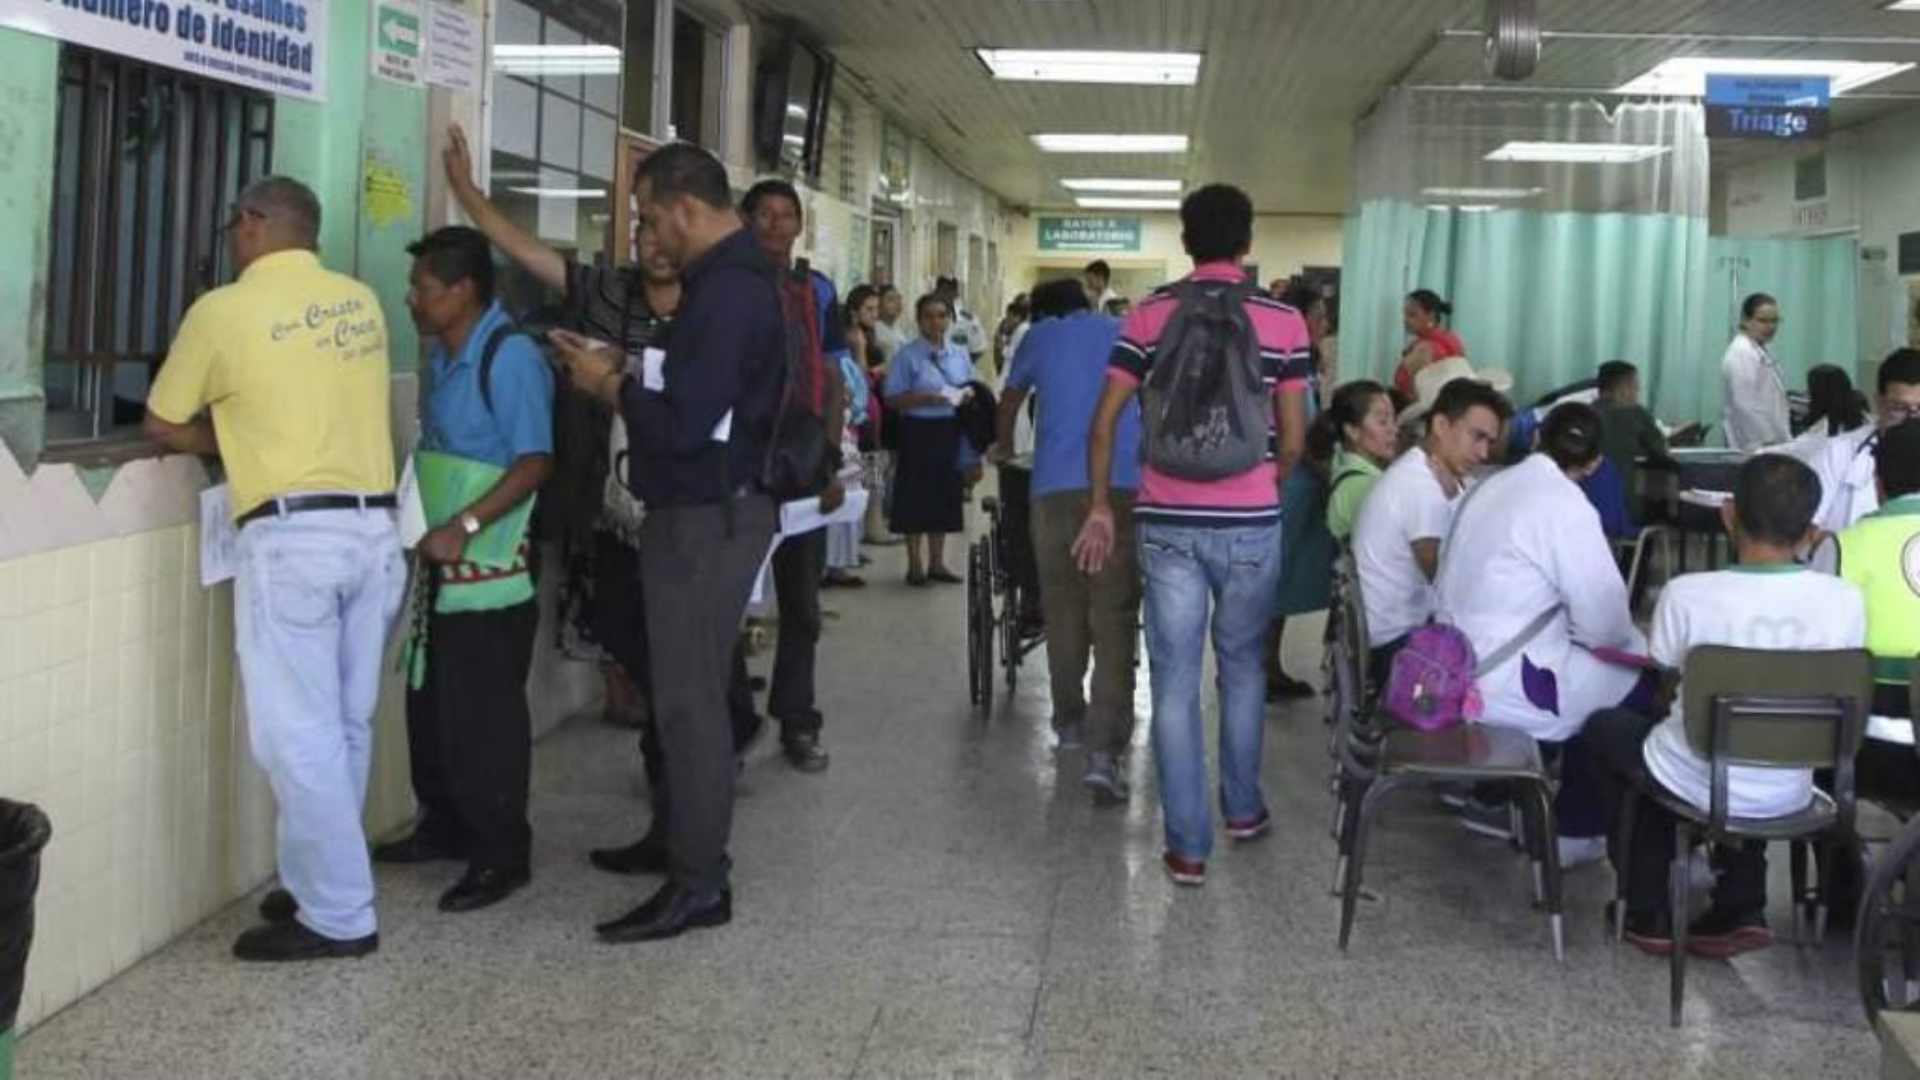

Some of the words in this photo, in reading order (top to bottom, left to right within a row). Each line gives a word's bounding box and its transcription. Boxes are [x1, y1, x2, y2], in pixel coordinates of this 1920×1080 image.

[176, 3, 207, 44] de
[211, 11, 313, 74] identidad
[1729, 109, 1809, 136] Triage
